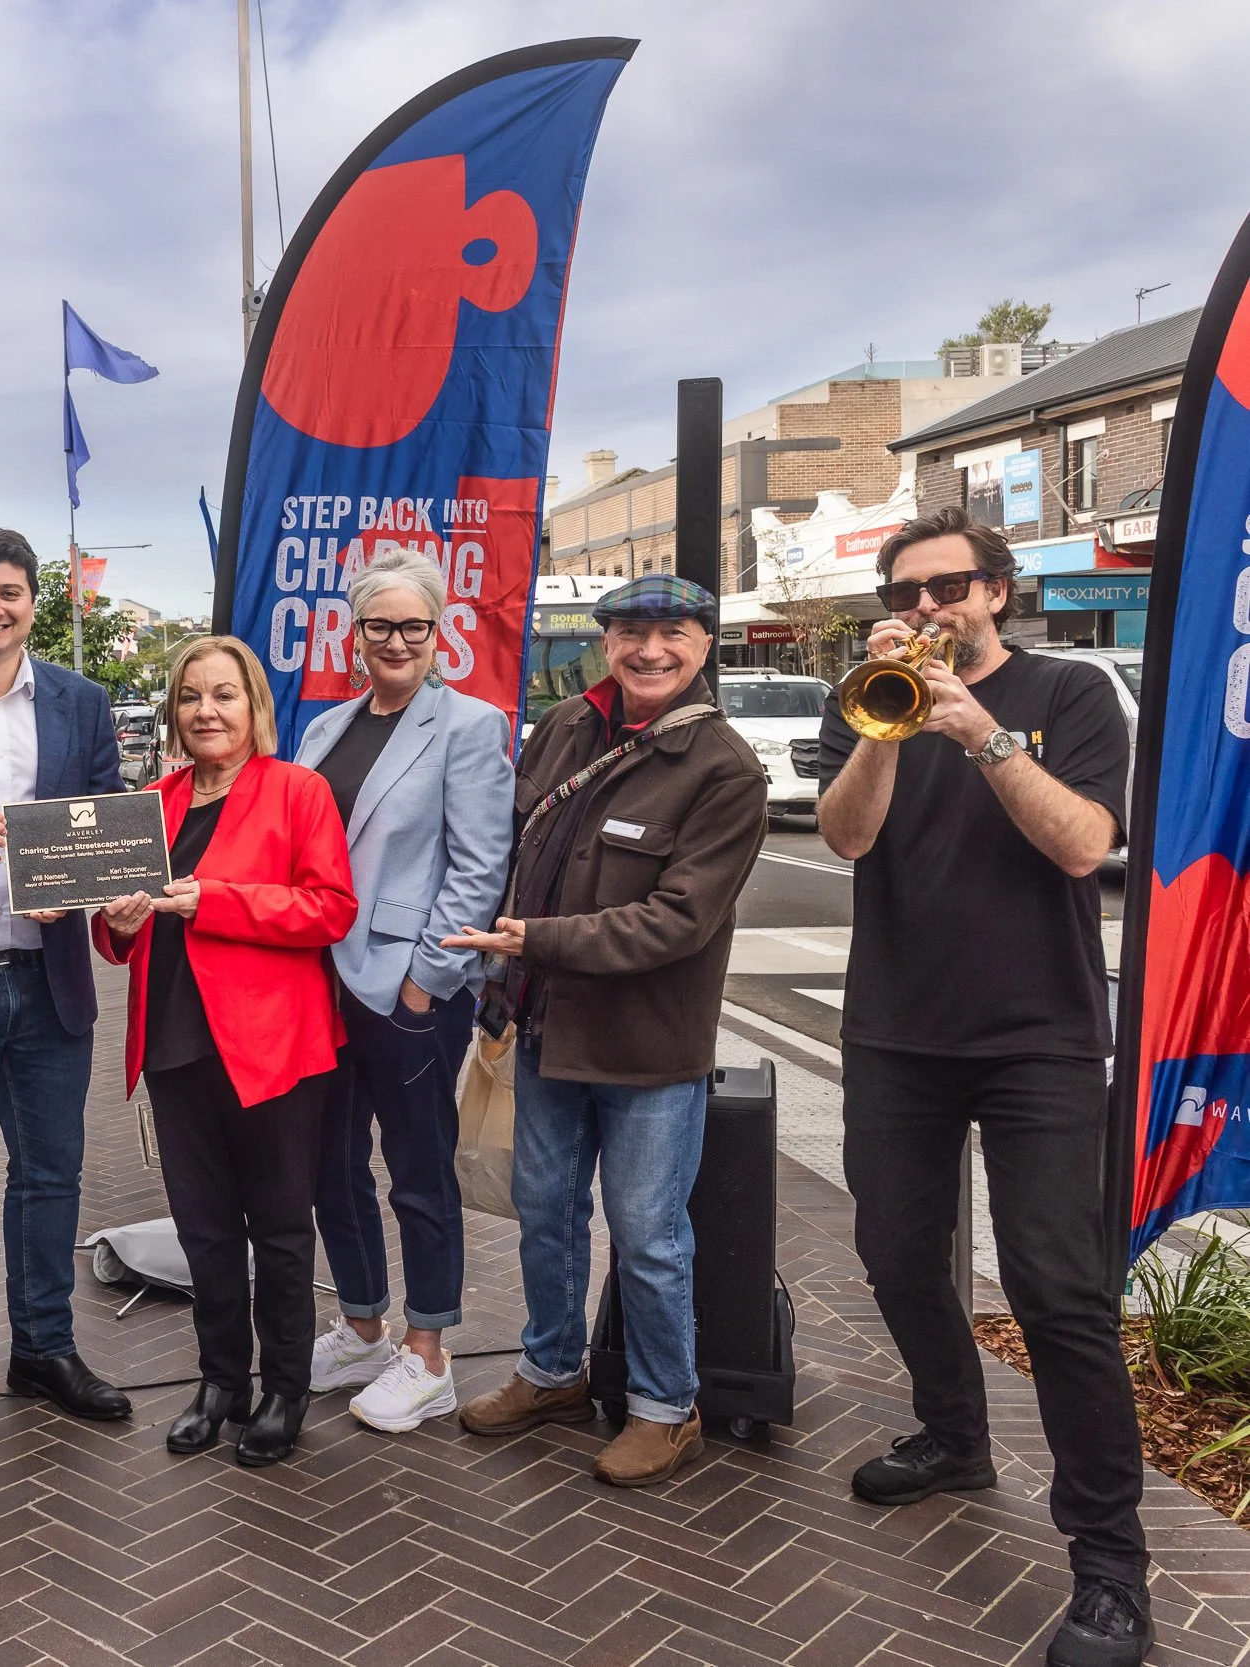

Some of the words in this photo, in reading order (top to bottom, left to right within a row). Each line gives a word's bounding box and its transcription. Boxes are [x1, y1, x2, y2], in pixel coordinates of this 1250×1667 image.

[281, 495, 351, 530] STEP
[358, 497, 433, 532] BACK
[443, 499, 488, 524] INTO
[846, 535, 882, 552] bathroom
[1048, 587, 1132, 600] PROXIMITY
[550, 614, 587, 623] BONDI
[270, 596, 477, 681] CRS
[752, 631, 791, 639] bathroom
[66, 829, 104, 837] WAVERLEY
[19, 847, 49, 855] Charing
[74, 841, 119, 850] Streetscape
[120, 837, 153, 846] Upgrade
[110, 867, 122, 875] Keri
[123, 866, 147, 874] Spooner
[1212, 1101, 1250, 1122] WA
